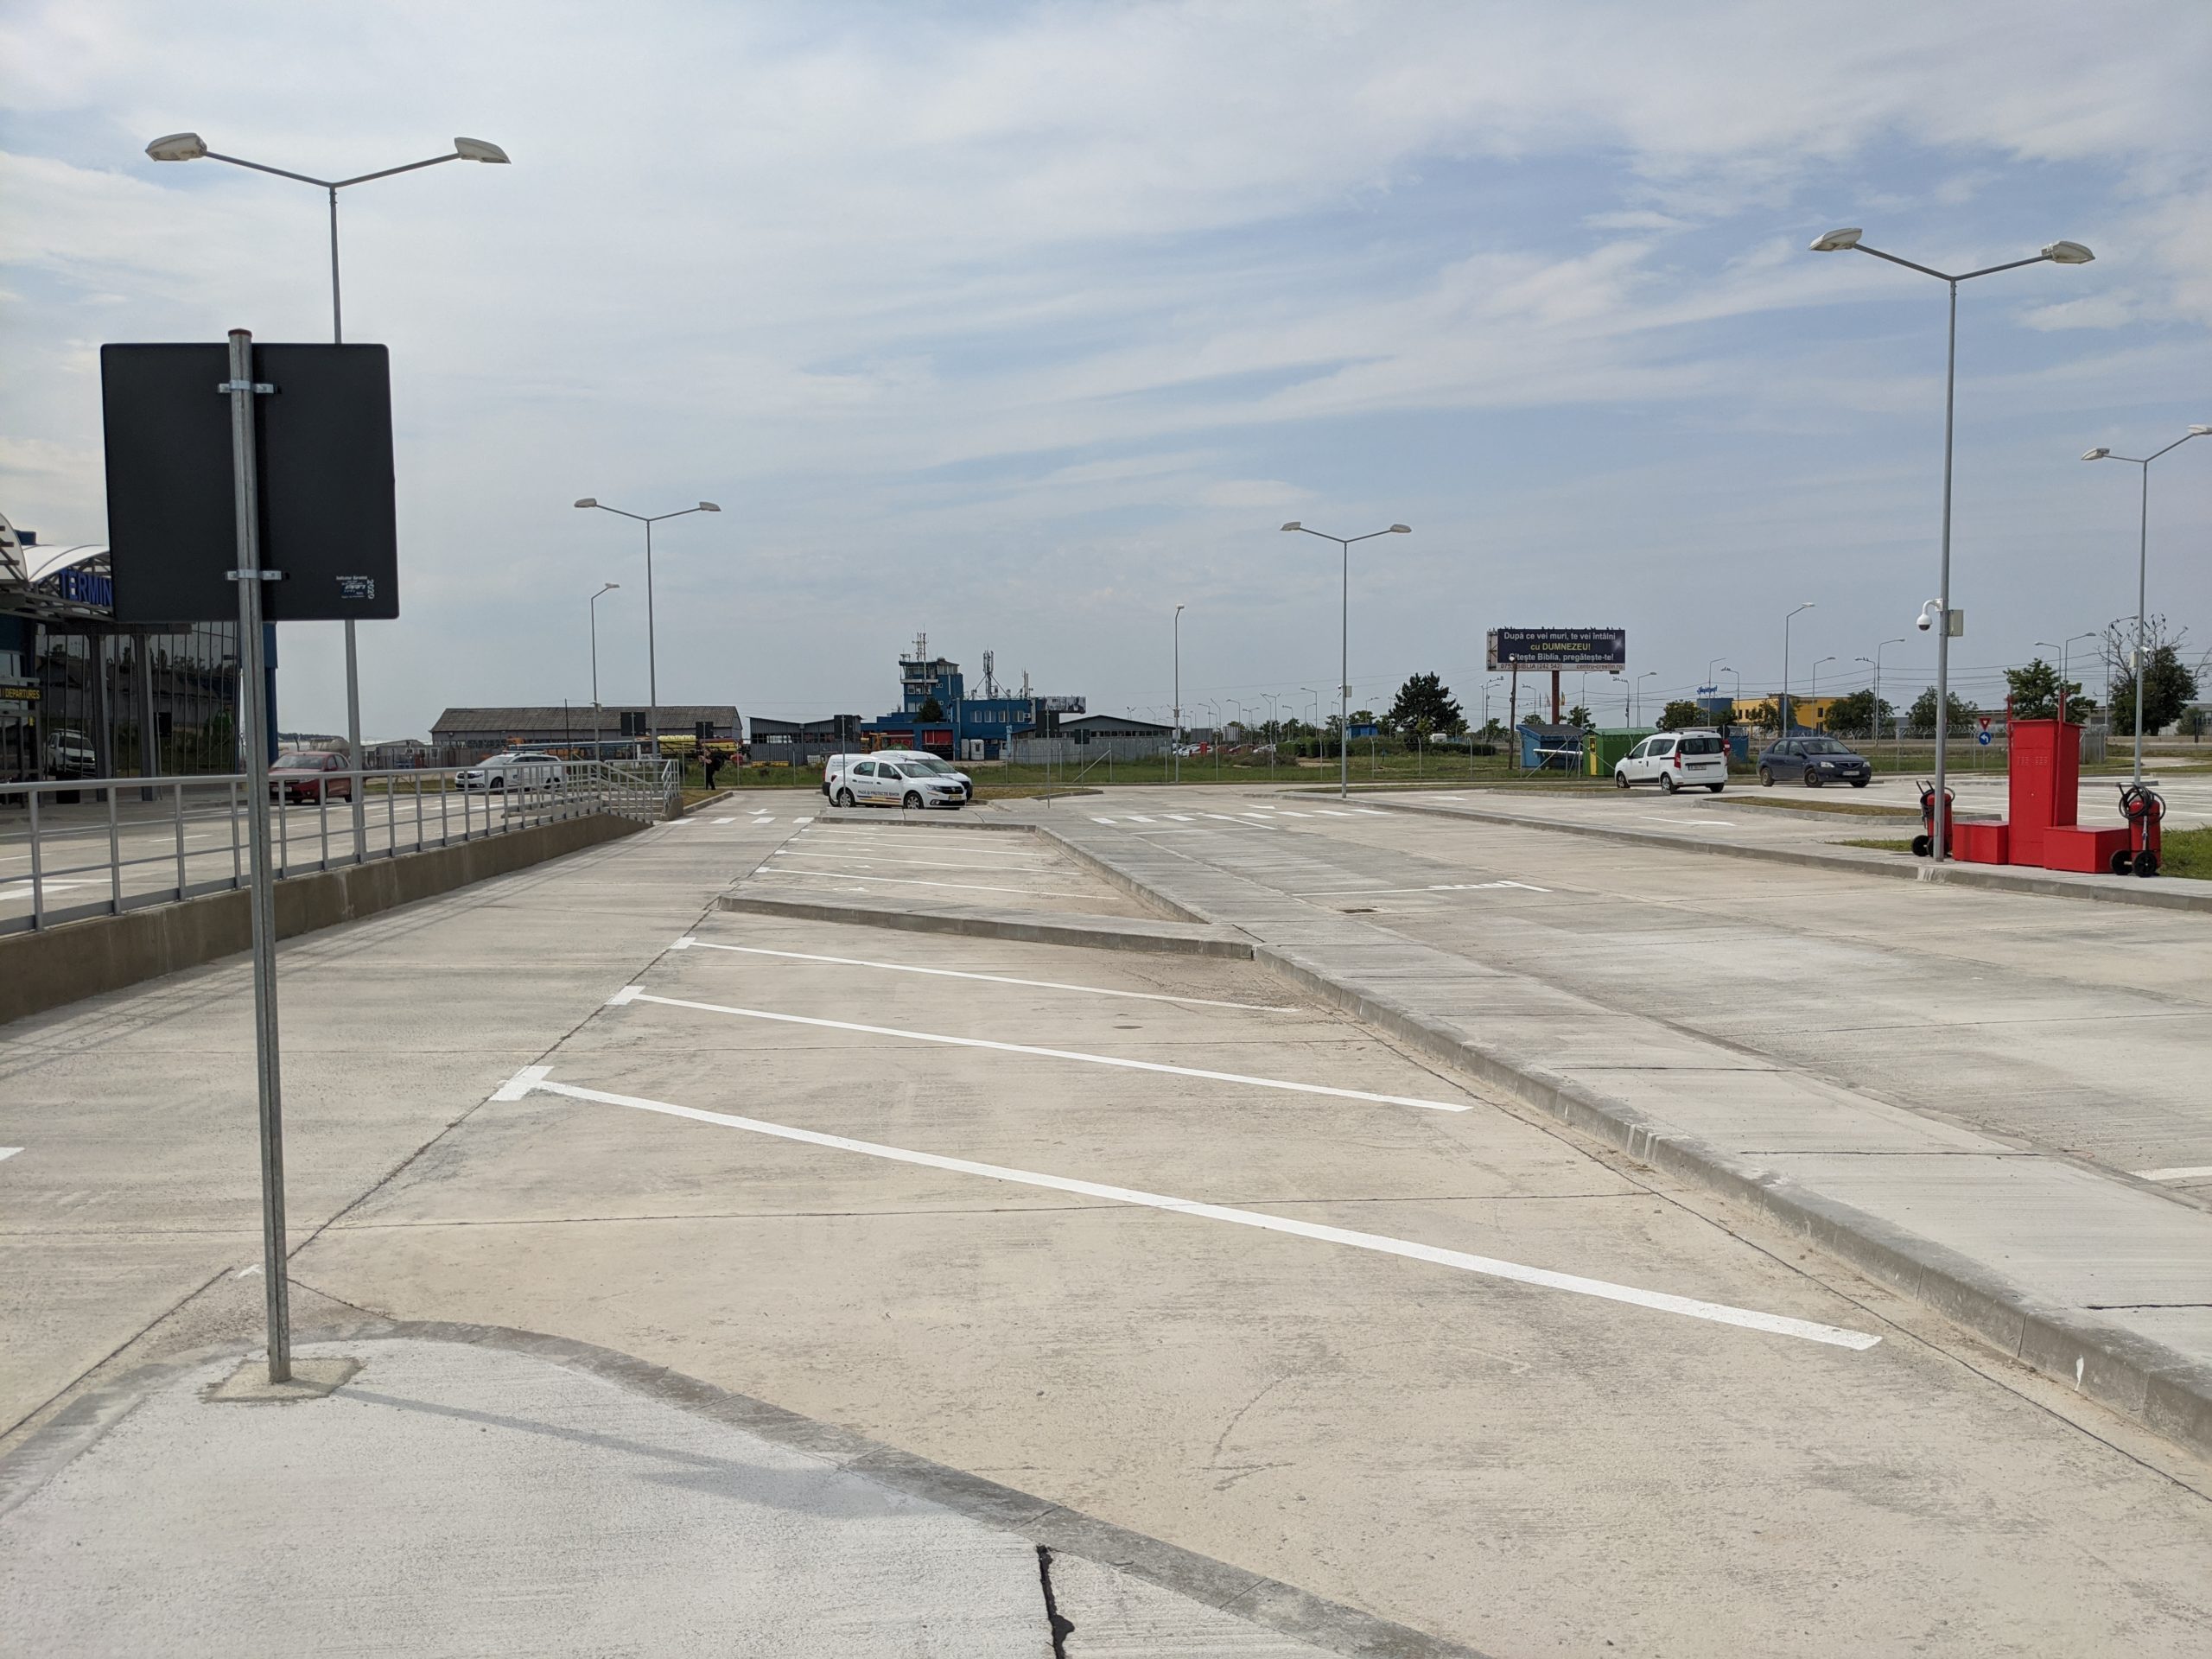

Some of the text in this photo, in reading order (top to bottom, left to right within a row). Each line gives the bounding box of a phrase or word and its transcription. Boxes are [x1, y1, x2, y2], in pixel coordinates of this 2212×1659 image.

[1503, 632, 1524, 641] După
[1580, 632, 1591, 640] vei
[1592, 632, 1616, 640] întâlni
[1537, 653, 1560, 662] Biblia,
[1563, 652, 1614, 663] pregătește-te!
[5, 688, 41, 699] DEPARTURES
